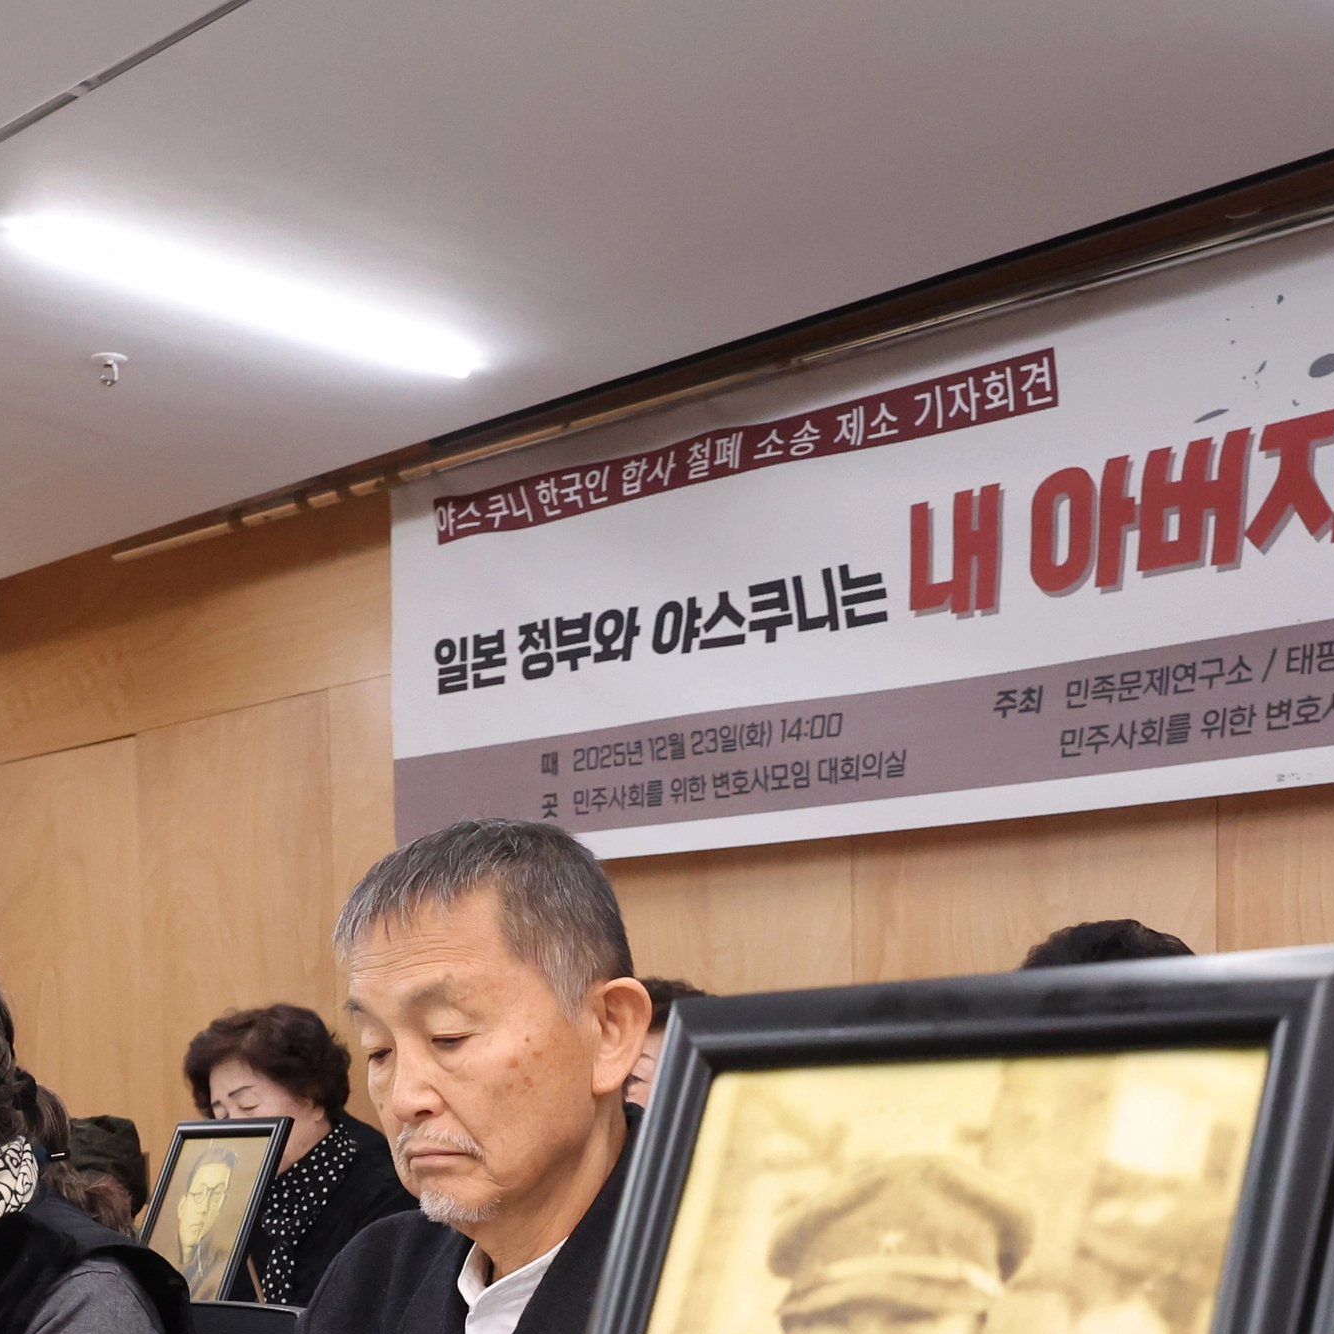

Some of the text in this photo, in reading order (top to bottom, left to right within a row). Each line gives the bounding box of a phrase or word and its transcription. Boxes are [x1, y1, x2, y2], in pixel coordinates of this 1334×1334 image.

[436, 356, 1054, 537] 야스쿠니 한국인 합사 철폐 소송 제소 기자회견
[434, 628, 507, 695] 일본
[517, 606, 641, 682] 정부와
[652, 563, 889, 655] 야스쿠니는
[909, 483, 1002, 617] 내
[993, 685, 1044, 718] 주최
[1065, 654, 1253, 710] 민족문제연구소
[541, 712, 844, 777] 때 2025년 12월 23일(화) 14:00
[1059, 711, 1192, 758] 민주사회를
[1200, 703, 1257, 740] 위한
[541, 749, 907, 820] 곳 민주사회를 위한 변호사모임 대회의실
